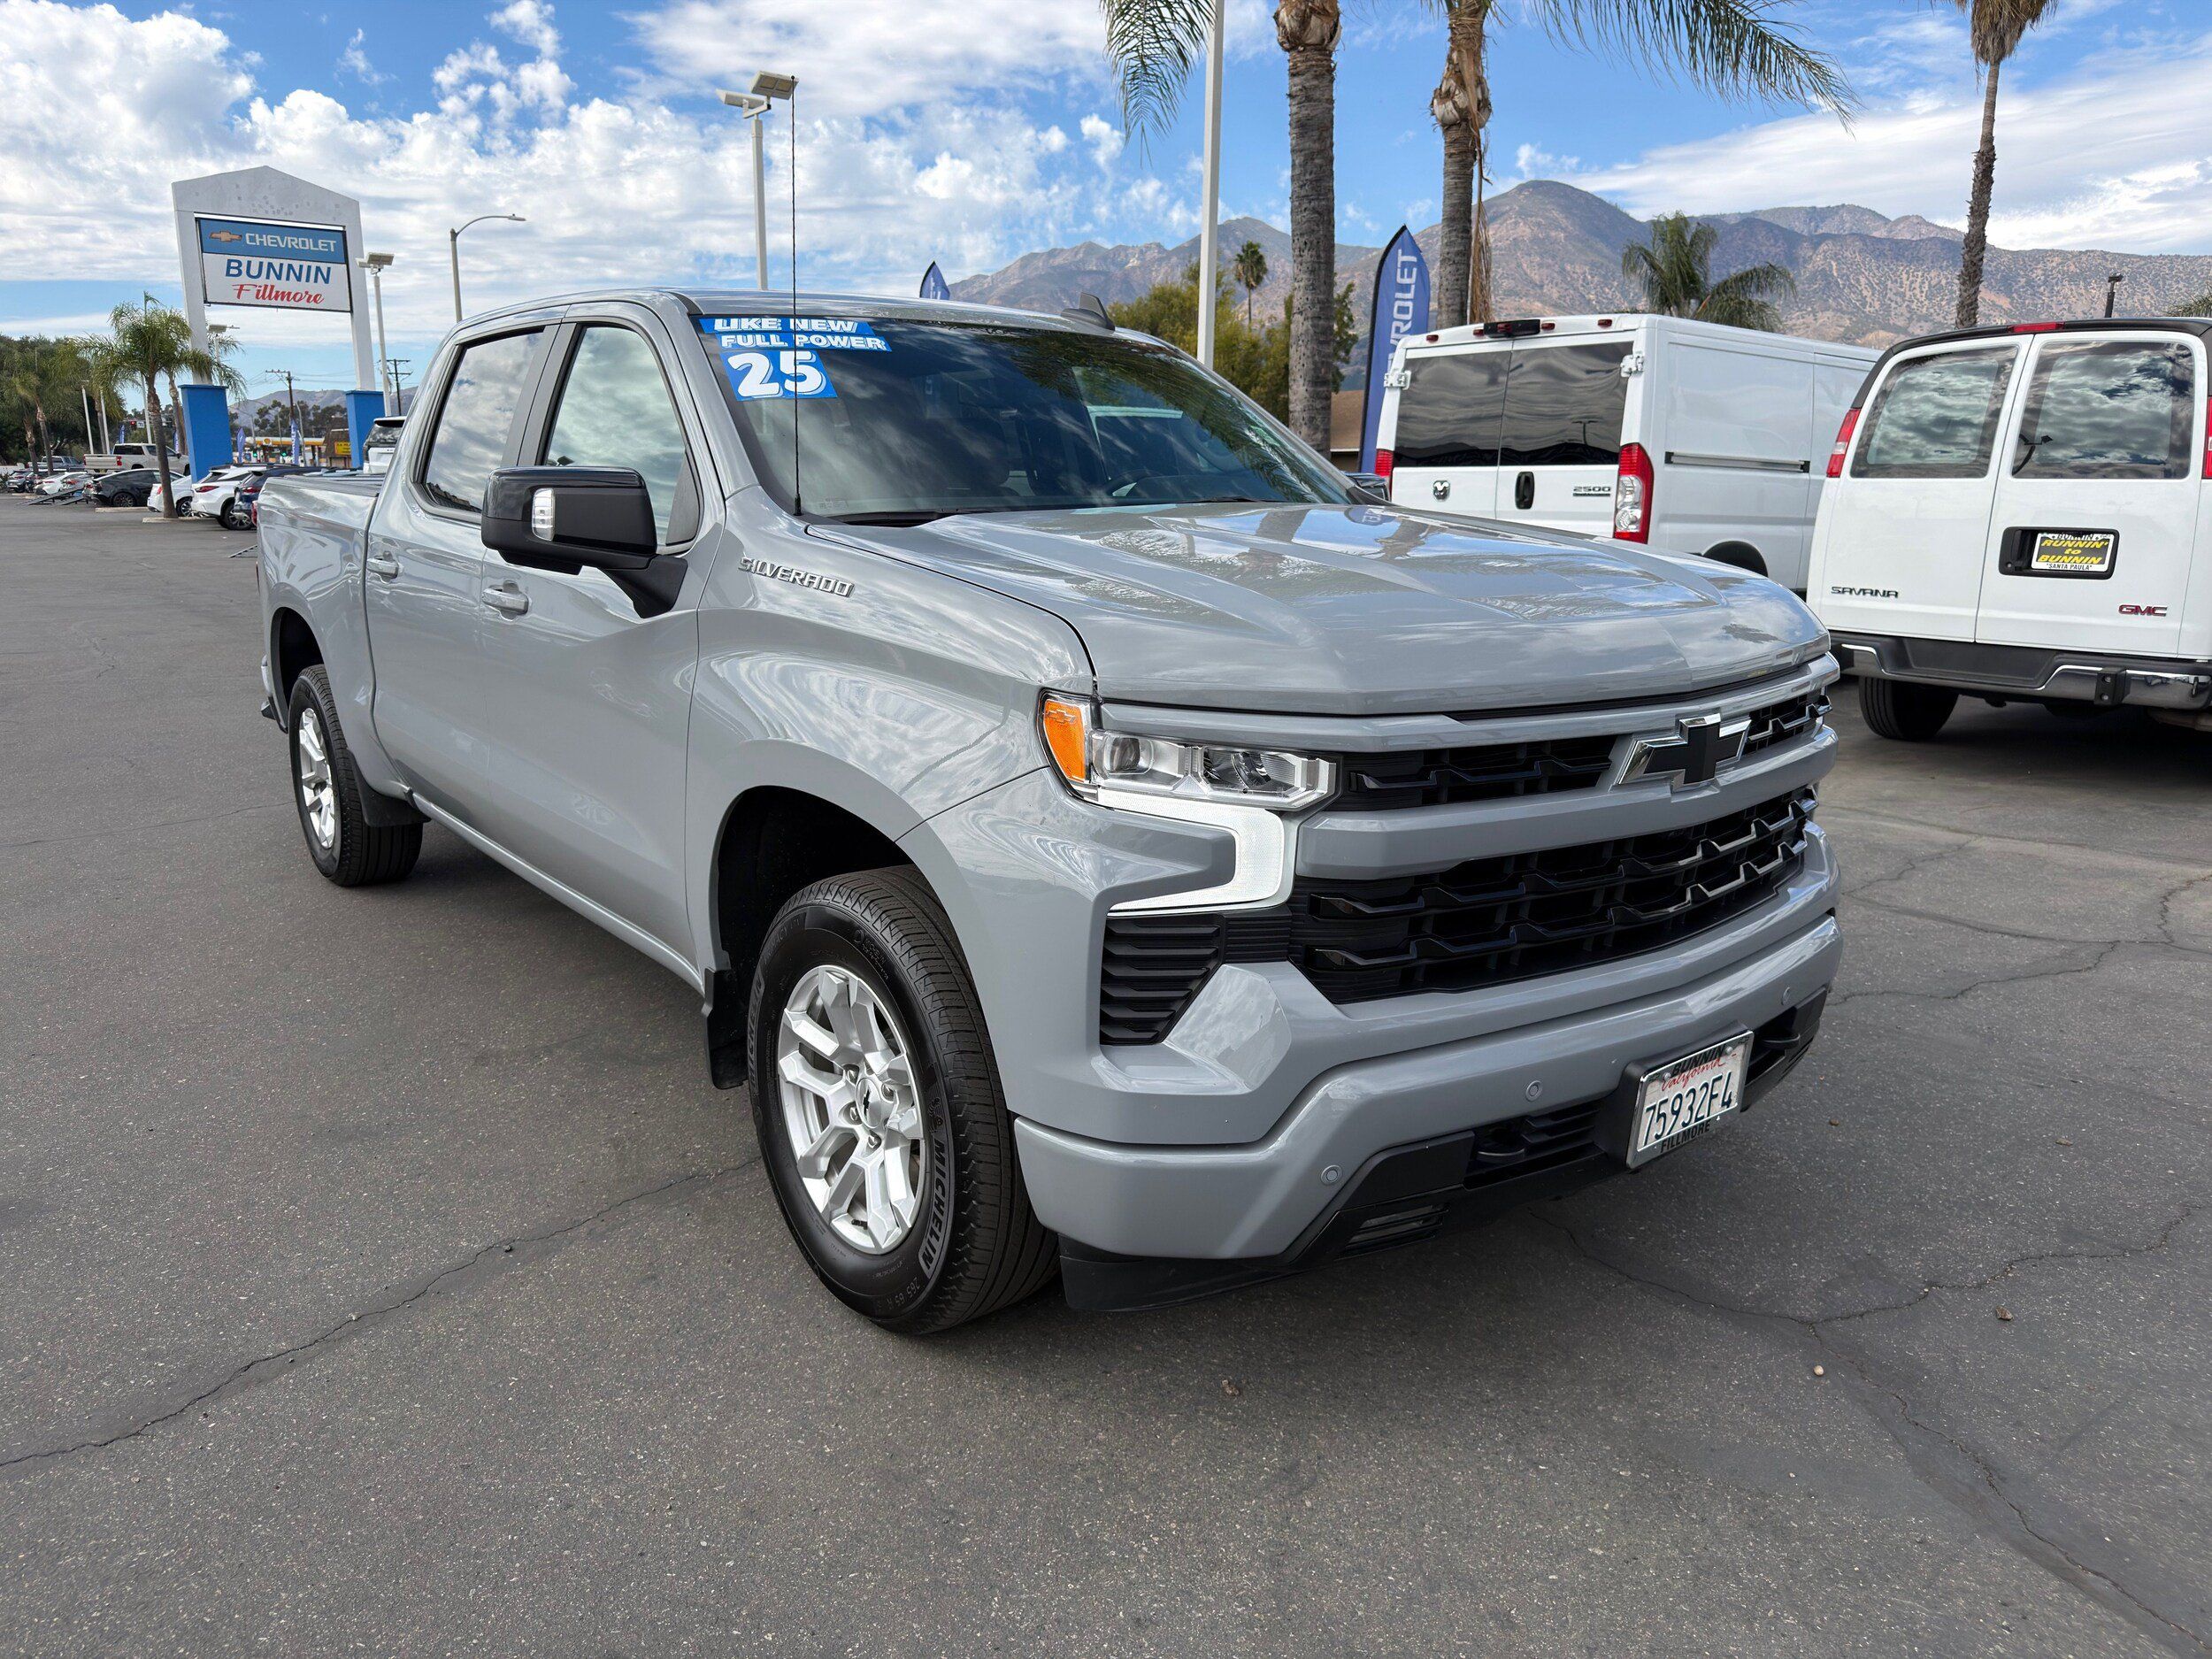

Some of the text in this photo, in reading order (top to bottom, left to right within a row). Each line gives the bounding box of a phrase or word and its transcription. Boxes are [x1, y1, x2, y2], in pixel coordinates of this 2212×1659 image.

[245, 233, 336, 252] CHEVROLET
[225, 258, 331, 284] BUNNIN
[232, 283, 324, 304] Fillmore
[714, 318, 858, 333] LIKE NEW
[721, 334, 887, 350] FULL POWER
[727, 350, 826, 398] 25
[2037, 555, 2102, 565] BUNNIN
[738, 556, 856, 598] SILVERADO
[1830, 586, 1899, 599] SAVANA
[2118, 604, 2168, 618] GMC
[1671, 1044, 1725, 1076] BUNNIN
[1642, 1070, 1733, 1147] 75932F4
[1660, 1119, 1711, 1154] FILLMORE
[922, 1138, 946, 1271] MICHELIN
